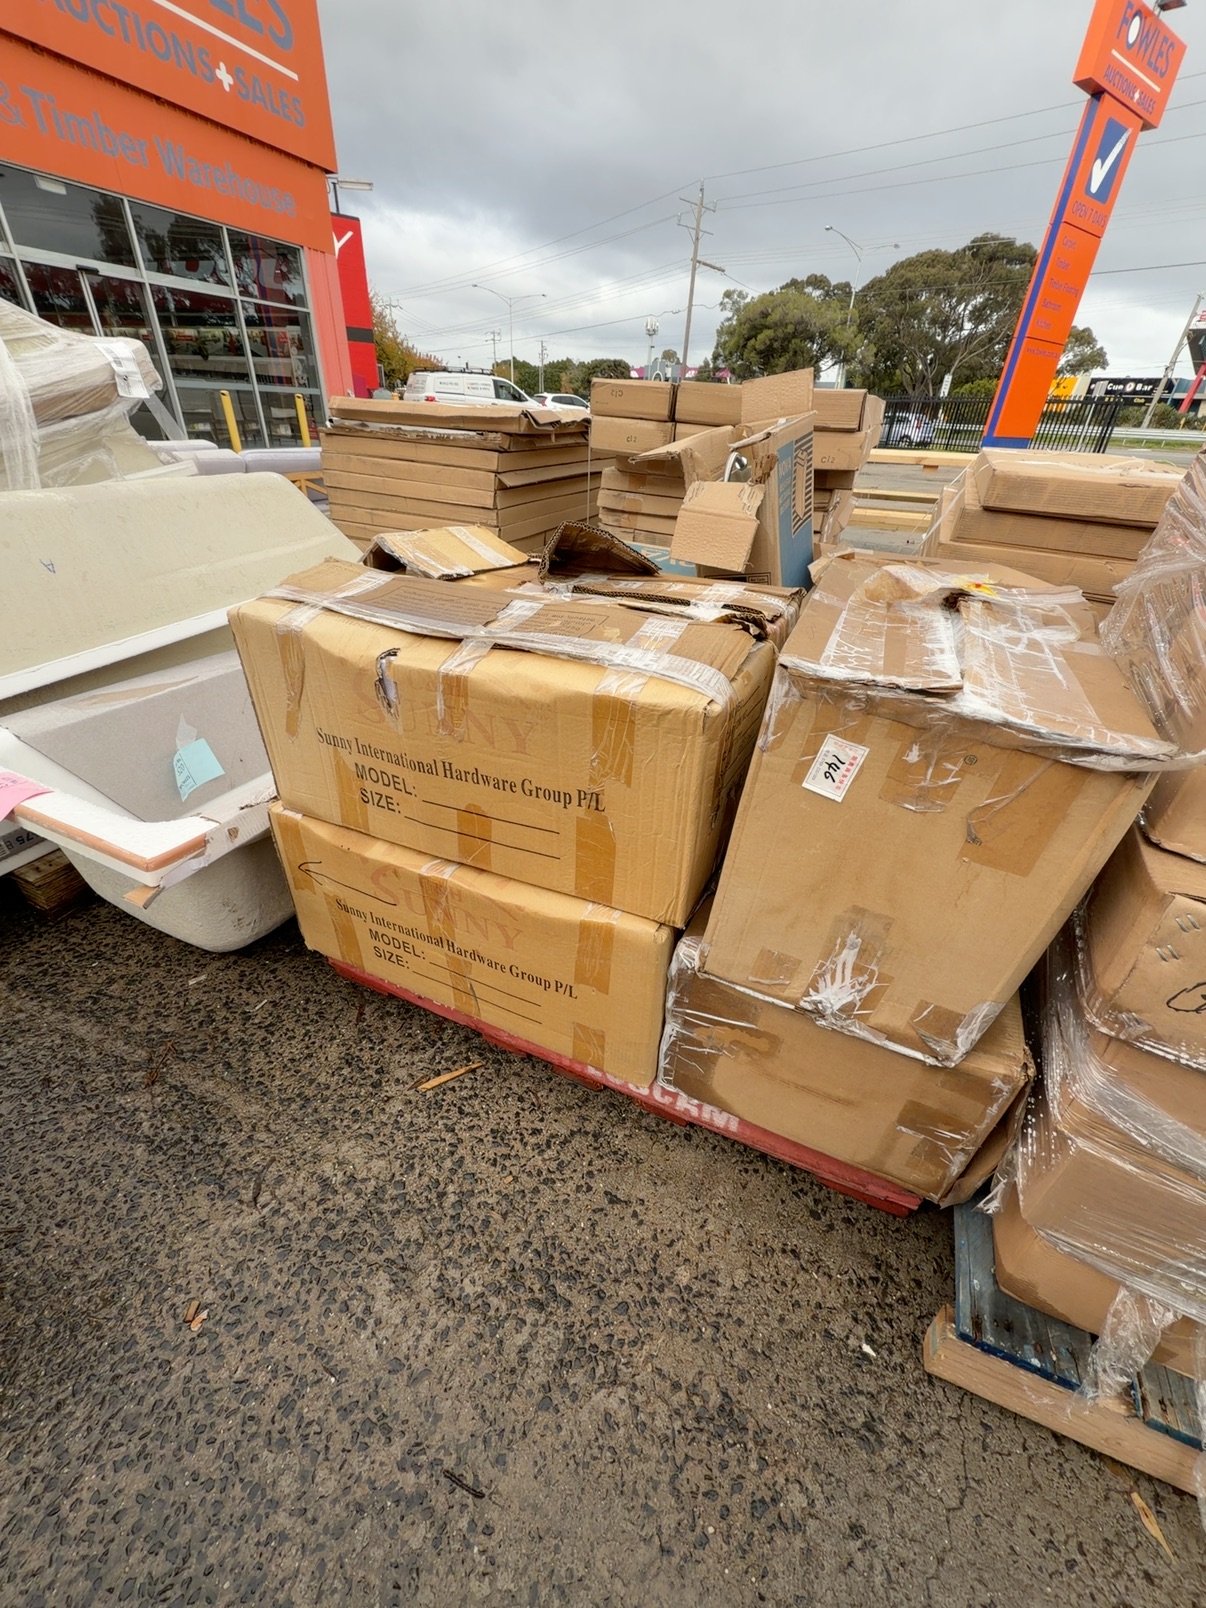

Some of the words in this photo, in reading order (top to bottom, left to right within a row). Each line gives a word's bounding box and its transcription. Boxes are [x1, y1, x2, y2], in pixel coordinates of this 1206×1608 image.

[1117, 2, 1175, 78] FOWLES
[234, 67, 305, 128] SALES
[20, 85, 149, 168] Timber
[153, 135, 297, 218] Warehouse
[1107, 382, 1124, 391] Cue
[1135, 383, 1153, 392] Bar
[316, 727, 353, 754] Sunny
[353, 736, 440, 777] International
[441, 760, 518, 793] Hardware
[520, 778, 572, 810] Group
[577, 788, 606, 812] P/L
[354, 762, 418, 798] MODEL:
[824, 754, 846, 783] 146
[359, 787, 401, 814] SIZE:
[336, 898, 369, 924] Sunny
[370, 908, 445, 949] International
[445, 938, 507, 974] Hardware
[509, 964, 552, 992] Group
[554, 980, 579, 1000] P/L
[369, 928, 427, 961] MODEL:
[373, 945, 411, 970] SIZE:
